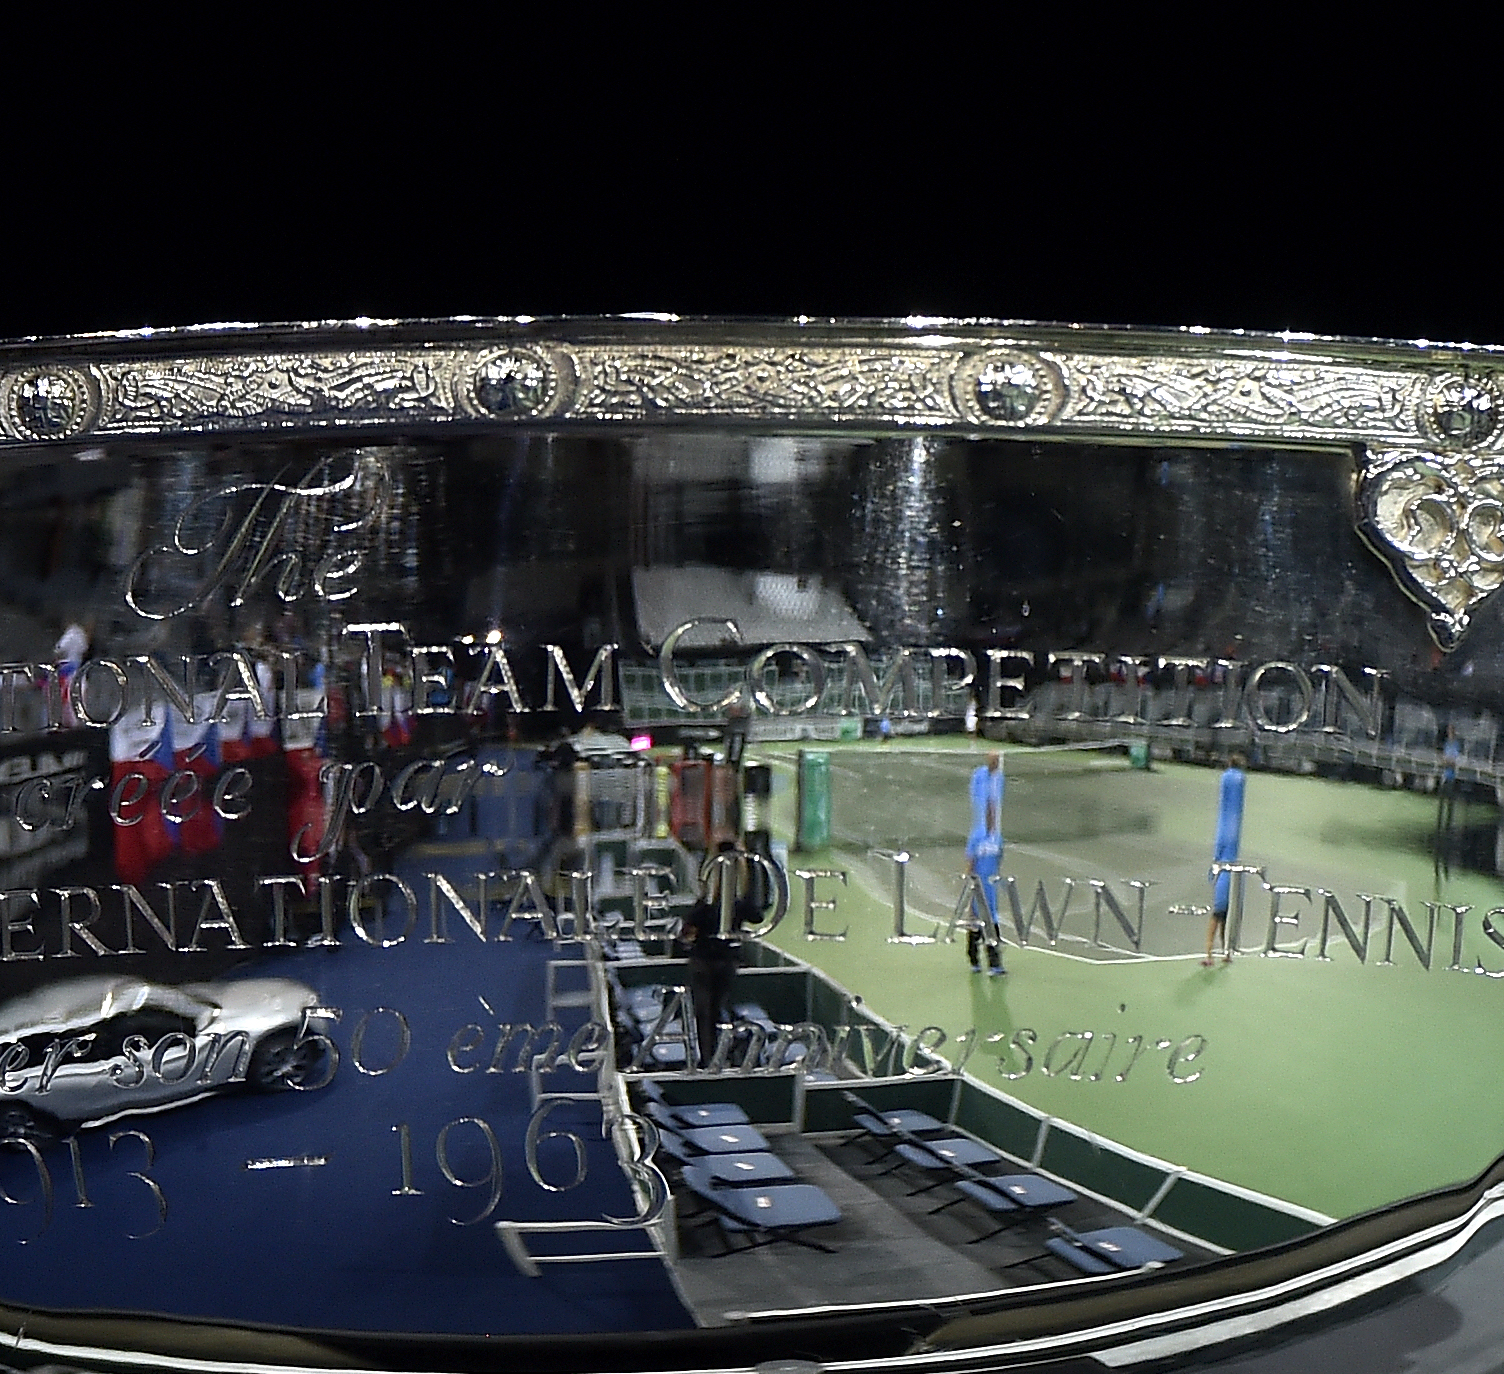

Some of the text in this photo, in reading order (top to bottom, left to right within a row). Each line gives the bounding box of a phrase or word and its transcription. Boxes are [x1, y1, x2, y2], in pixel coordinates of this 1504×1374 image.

[343, 622, 623, 717] TEAM
[658, 617, 1390, 739] COMPETITION
[289, 757, 514, 863] par
[698, 851, 848, 942] DE
[108, 1026, 249, 1089] son
[621, 984, 1209, 1084] Anniversaire
[390, 1099, 670, 1226] 1963
